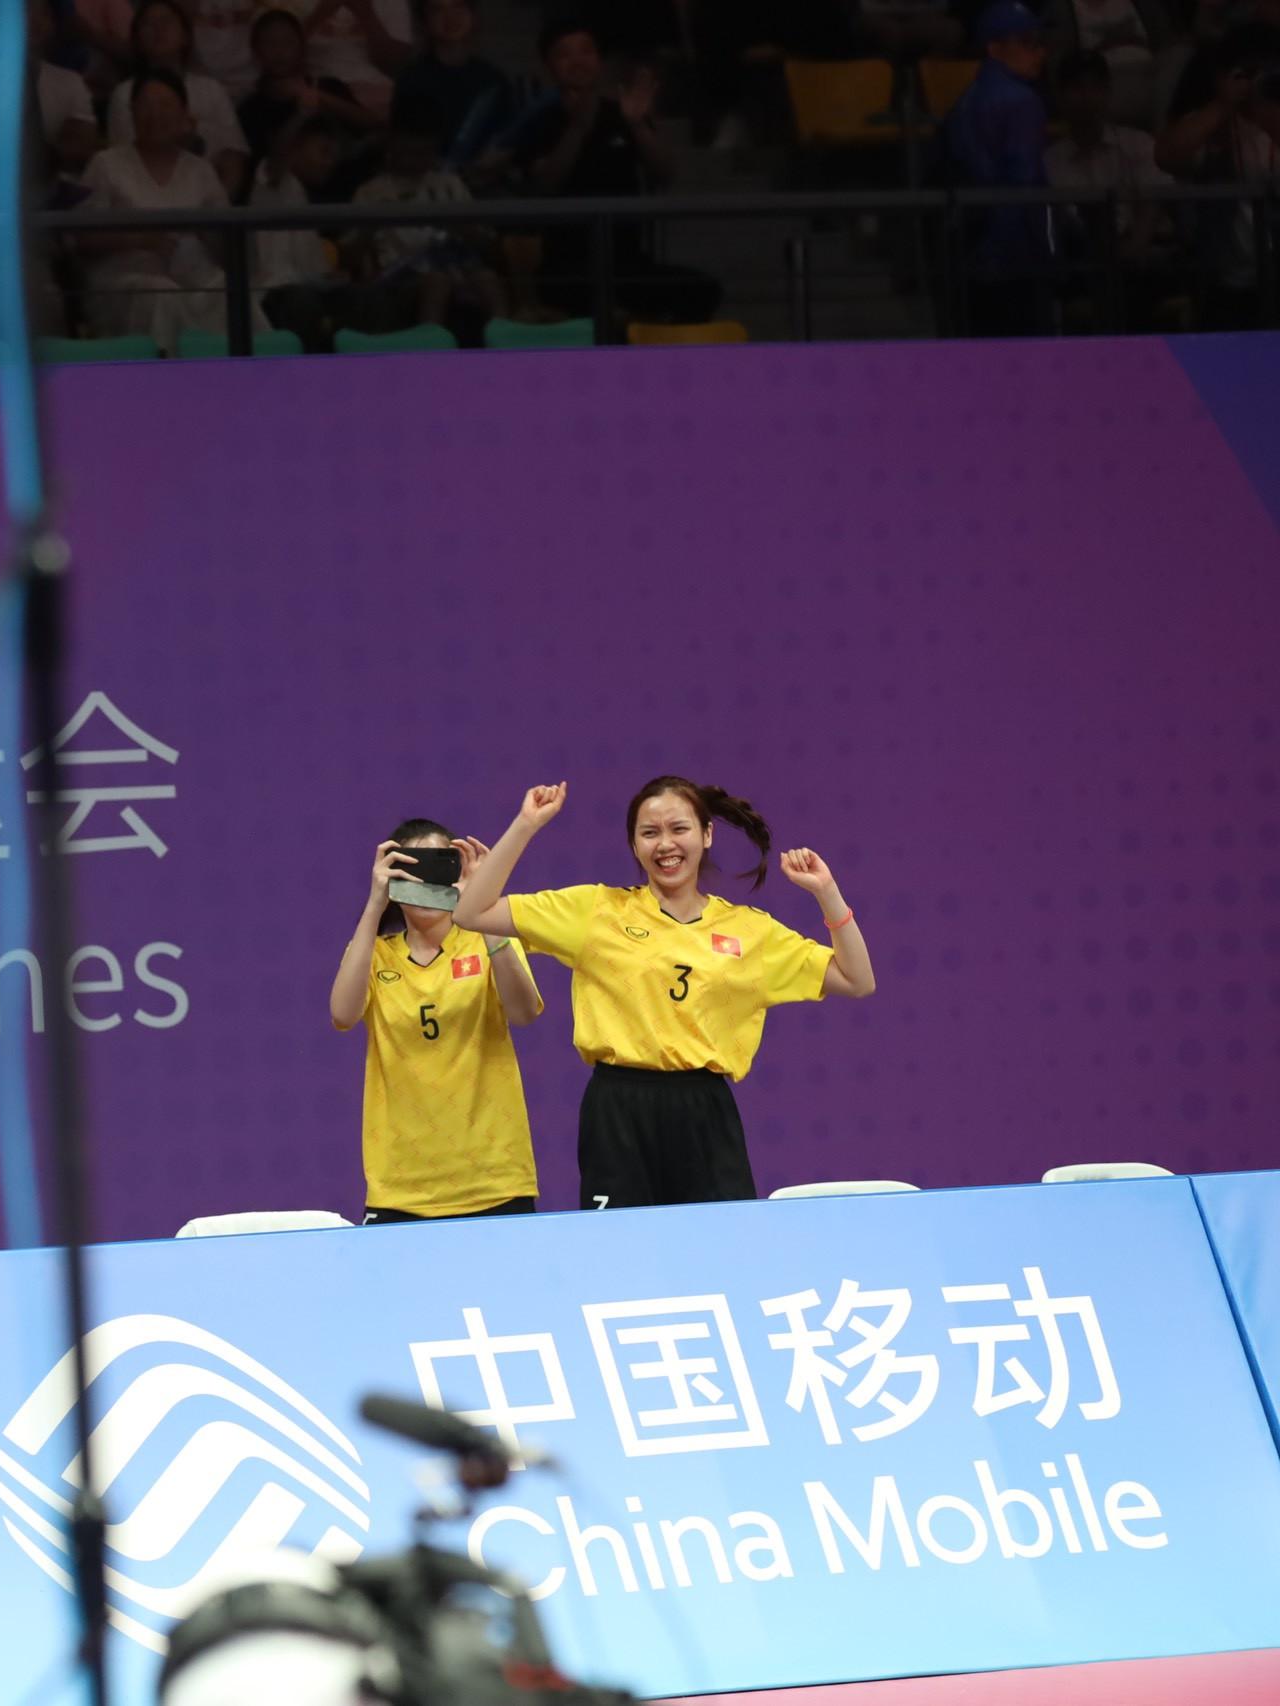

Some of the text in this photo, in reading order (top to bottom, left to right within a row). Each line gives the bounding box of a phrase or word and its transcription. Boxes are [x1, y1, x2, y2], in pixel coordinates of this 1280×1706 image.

[419, 1003, 441, 1041] 5
[668, 964, 693, 1003] 3
[408, 1266, 1123, 1472] 中国移动
[467, 1453, 1170, 1602] China Mobile
